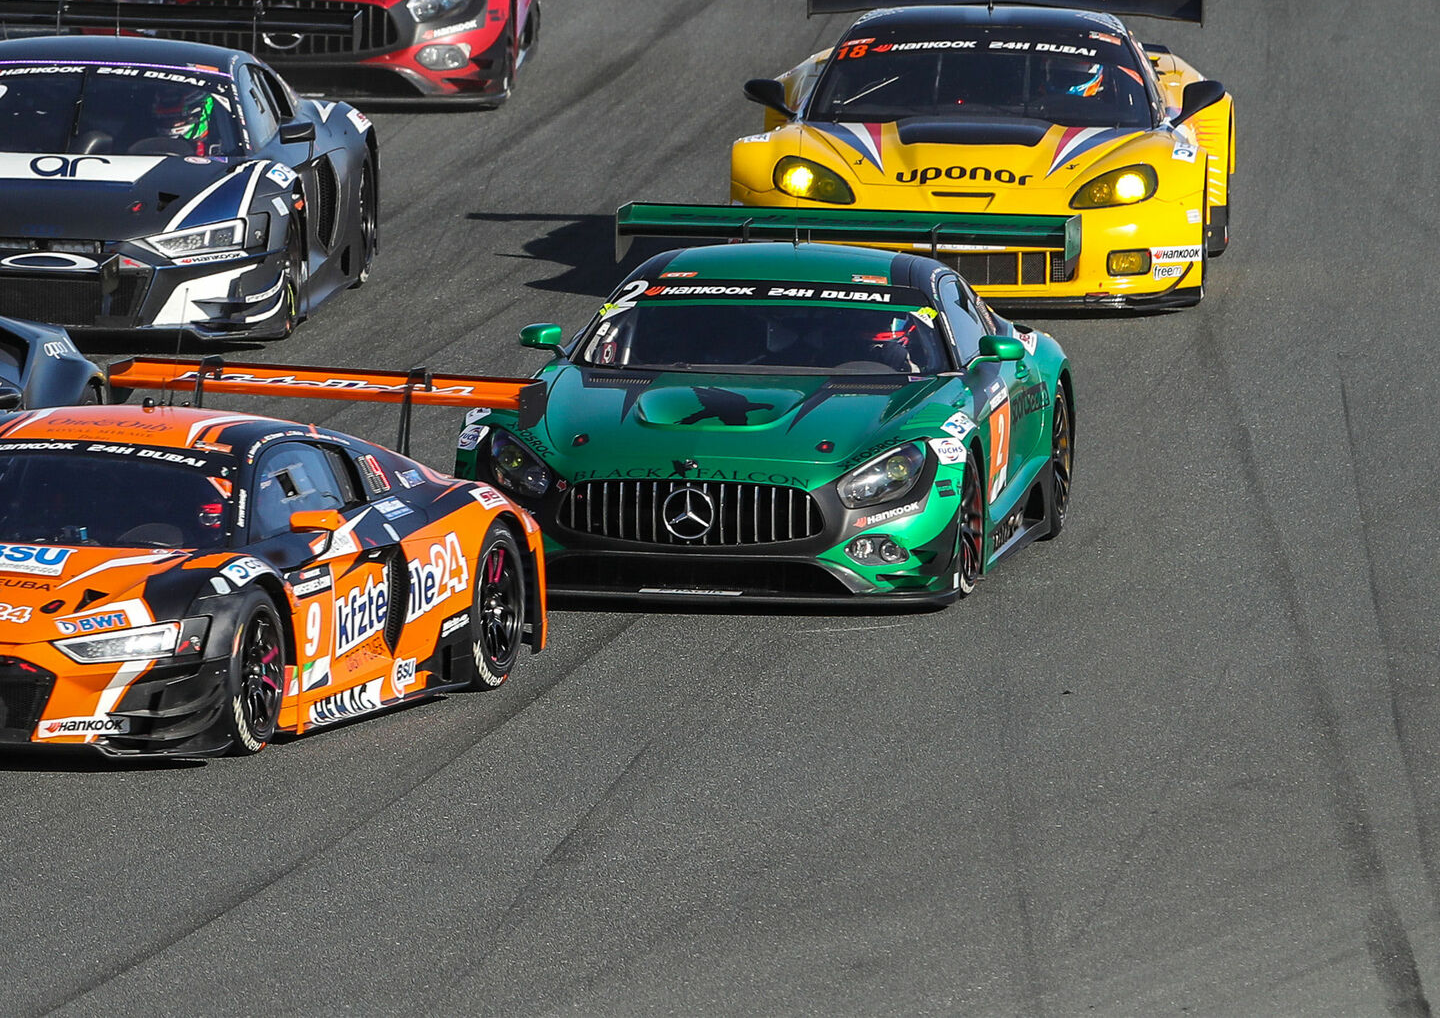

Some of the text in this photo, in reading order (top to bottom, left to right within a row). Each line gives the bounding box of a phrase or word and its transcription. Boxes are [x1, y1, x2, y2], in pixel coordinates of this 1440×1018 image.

[837, 44, 869, 61] 18
[988, 41, 1031, 51] 24H
[1035, 42, 1098, 57] DUBAI
[96, 66, 140, 77] 24H
[143, 70, 207, 88] DUBAI
[29, 155, 111, 178] ar
[1152, 264, 1184, 281] freem
[616, 280, 650, 308] 2
[767, 287, 814, 298] 24H
[820, 290, 892, 303] DUBAI
[937, 445, 964, 455] FUCHS
[995, 413, 1006, 468] 2
[85, 443, 136, 456] 24H
[137, 449, 208, 468] DUBAI
[573, 468, 811, 488] BLACK FALCON
[77, 611, 127, 633] BWT
[304, 601, 322, 658] 9
[396, 660, 416, 681] BSU
